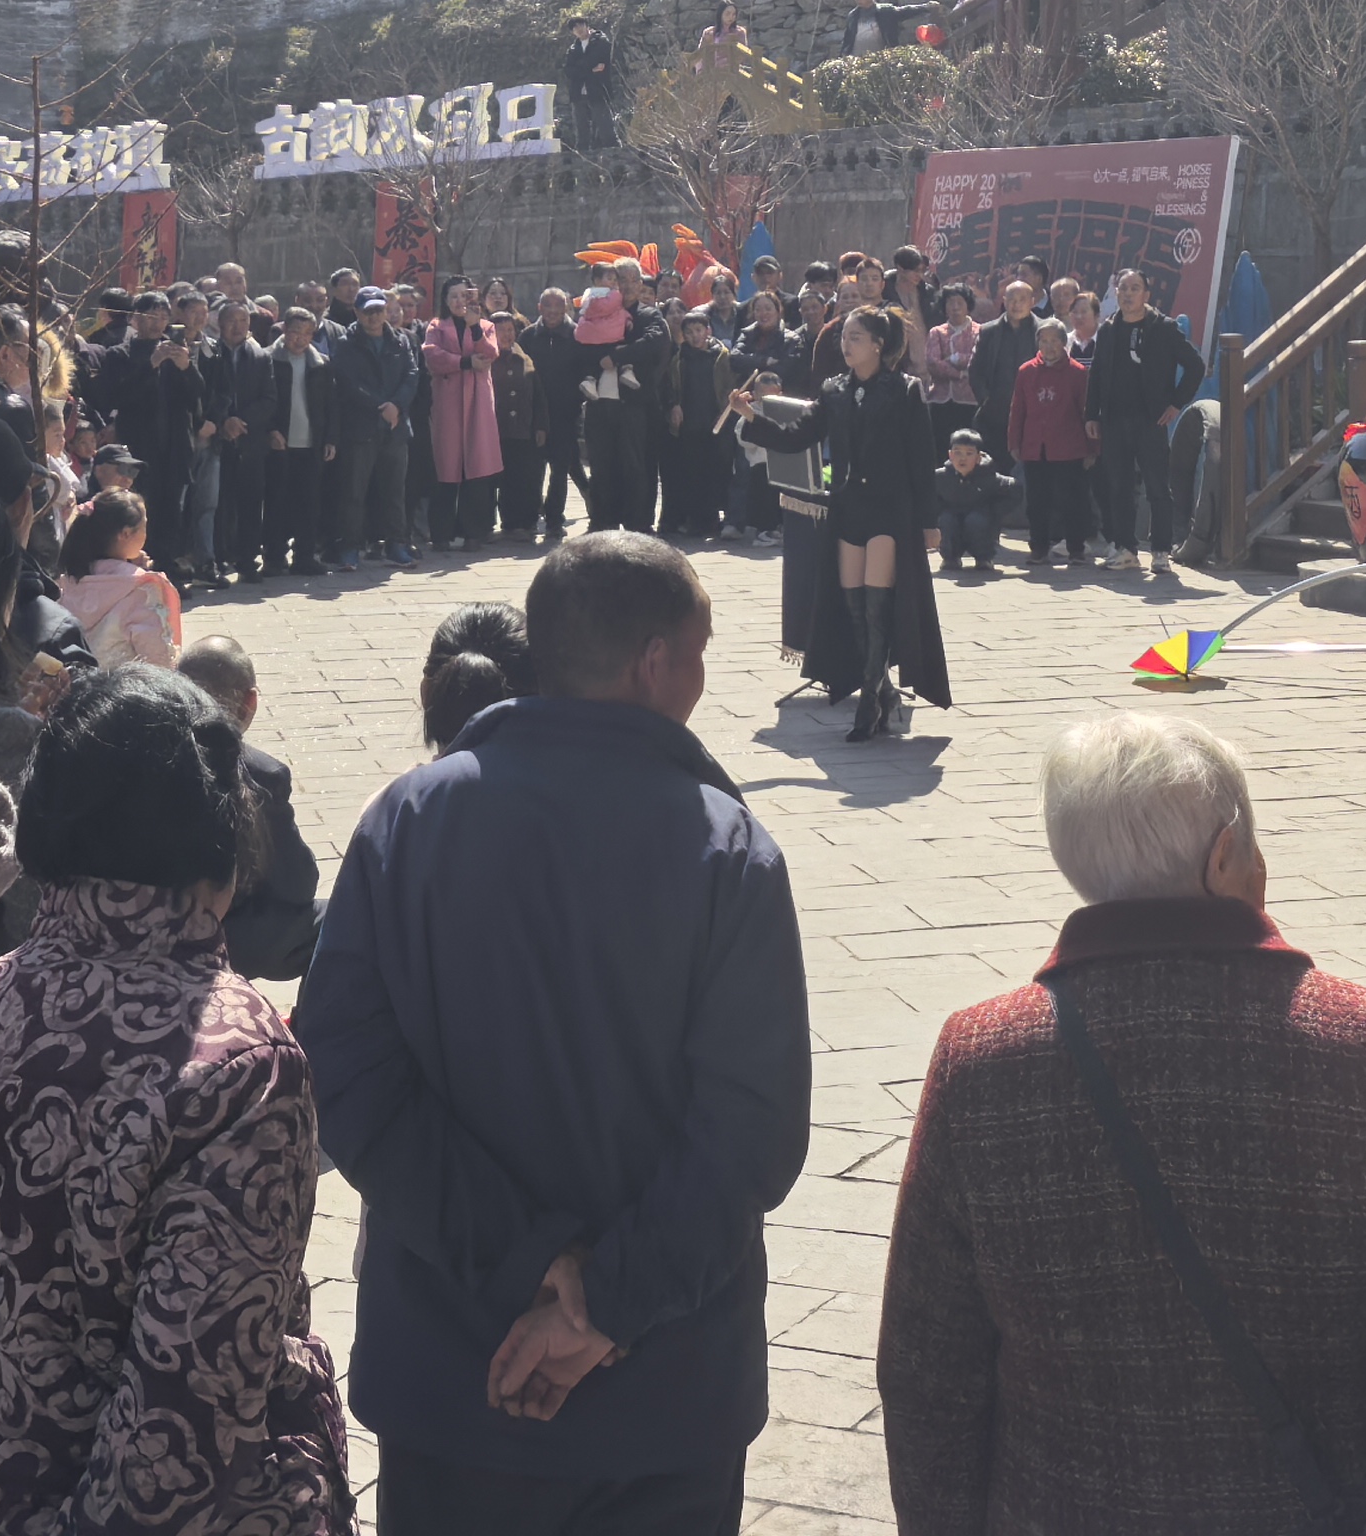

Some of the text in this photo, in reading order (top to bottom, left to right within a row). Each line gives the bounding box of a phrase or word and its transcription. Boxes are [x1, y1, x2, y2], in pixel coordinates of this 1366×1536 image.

[1177, 163, 1213, 177] HORSE
[935, 174, 977, 192] HAPPY
[980, 173, 996, 191] 20
[932, 191, 994, 210] NEW 26
[1154, 202, 1207, 216] BLESSINGS
[929, 211, 963, 229] YEAR
